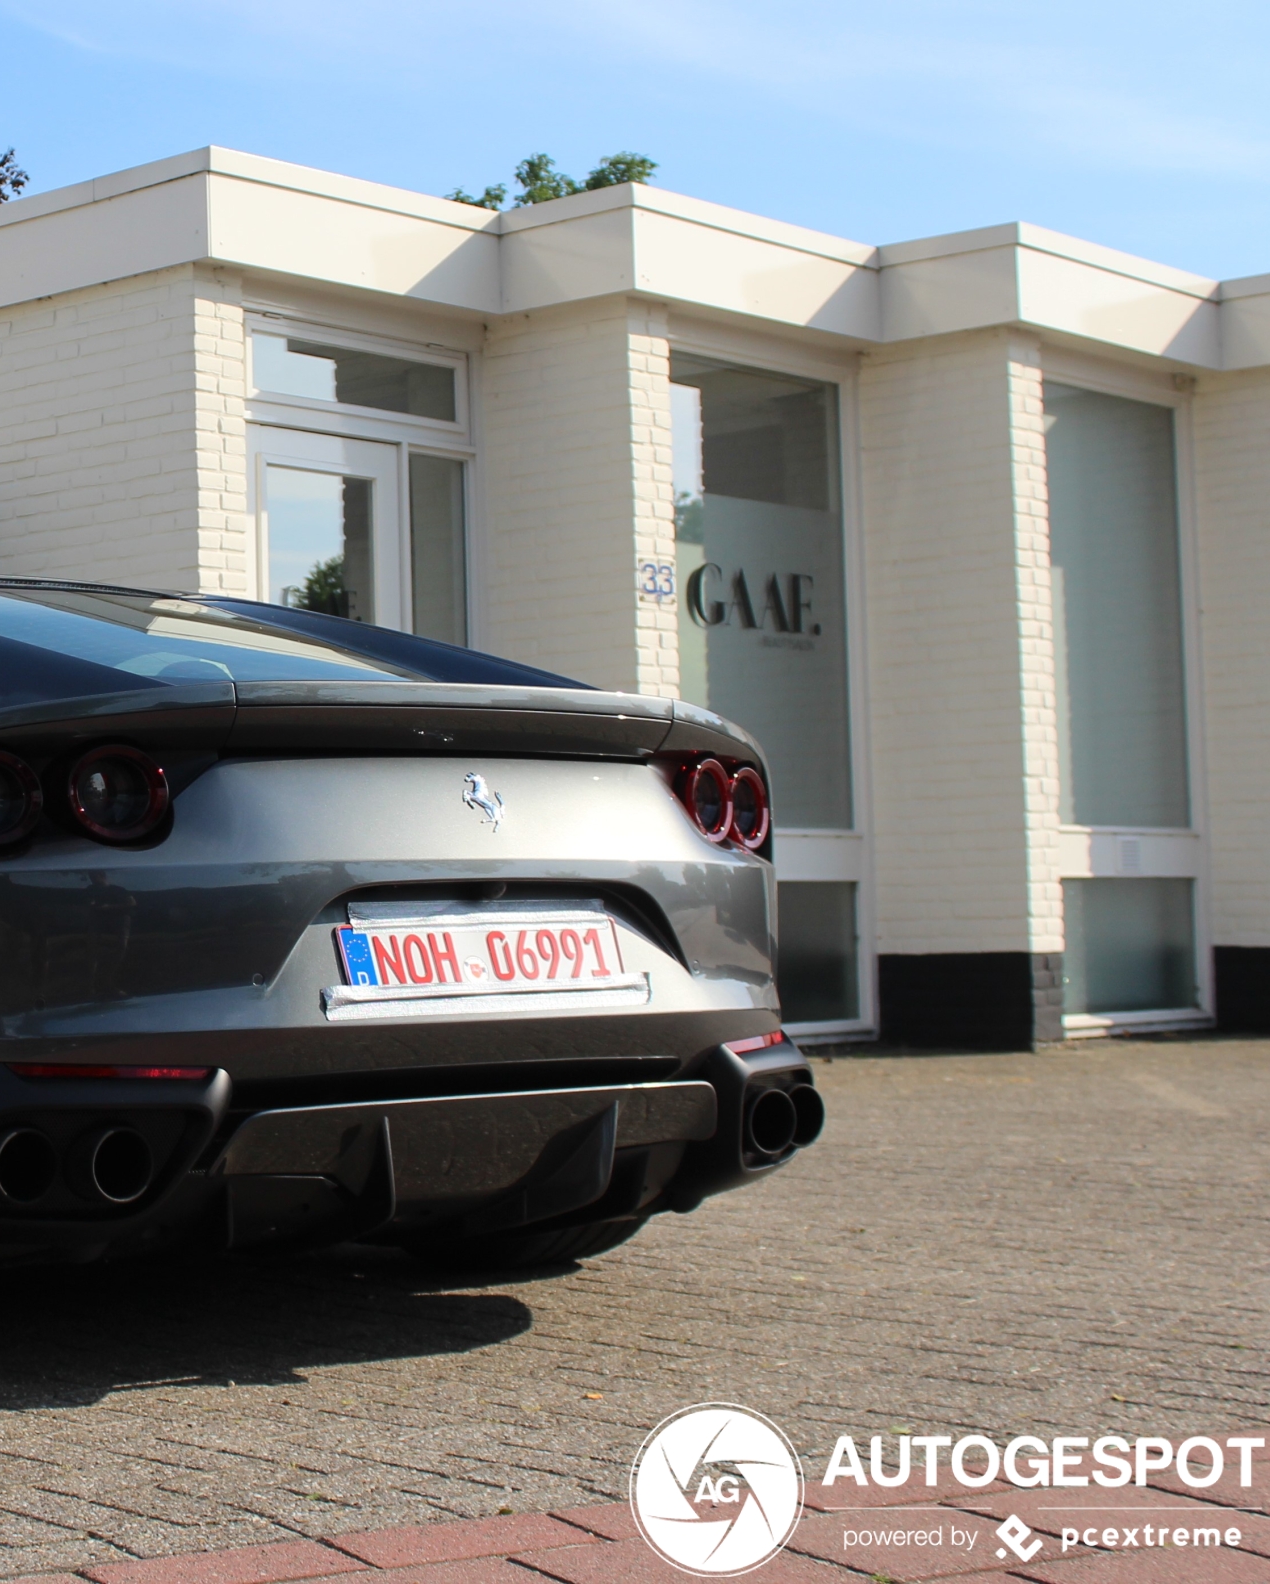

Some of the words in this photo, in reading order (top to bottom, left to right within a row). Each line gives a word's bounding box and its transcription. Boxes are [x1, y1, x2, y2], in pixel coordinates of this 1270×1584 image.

[642, 563, 673, 595] 33
[357, 971, 370, 986] D
[372, 932, 462, 985] NOH
[486, 928, 611, 982] 06991
